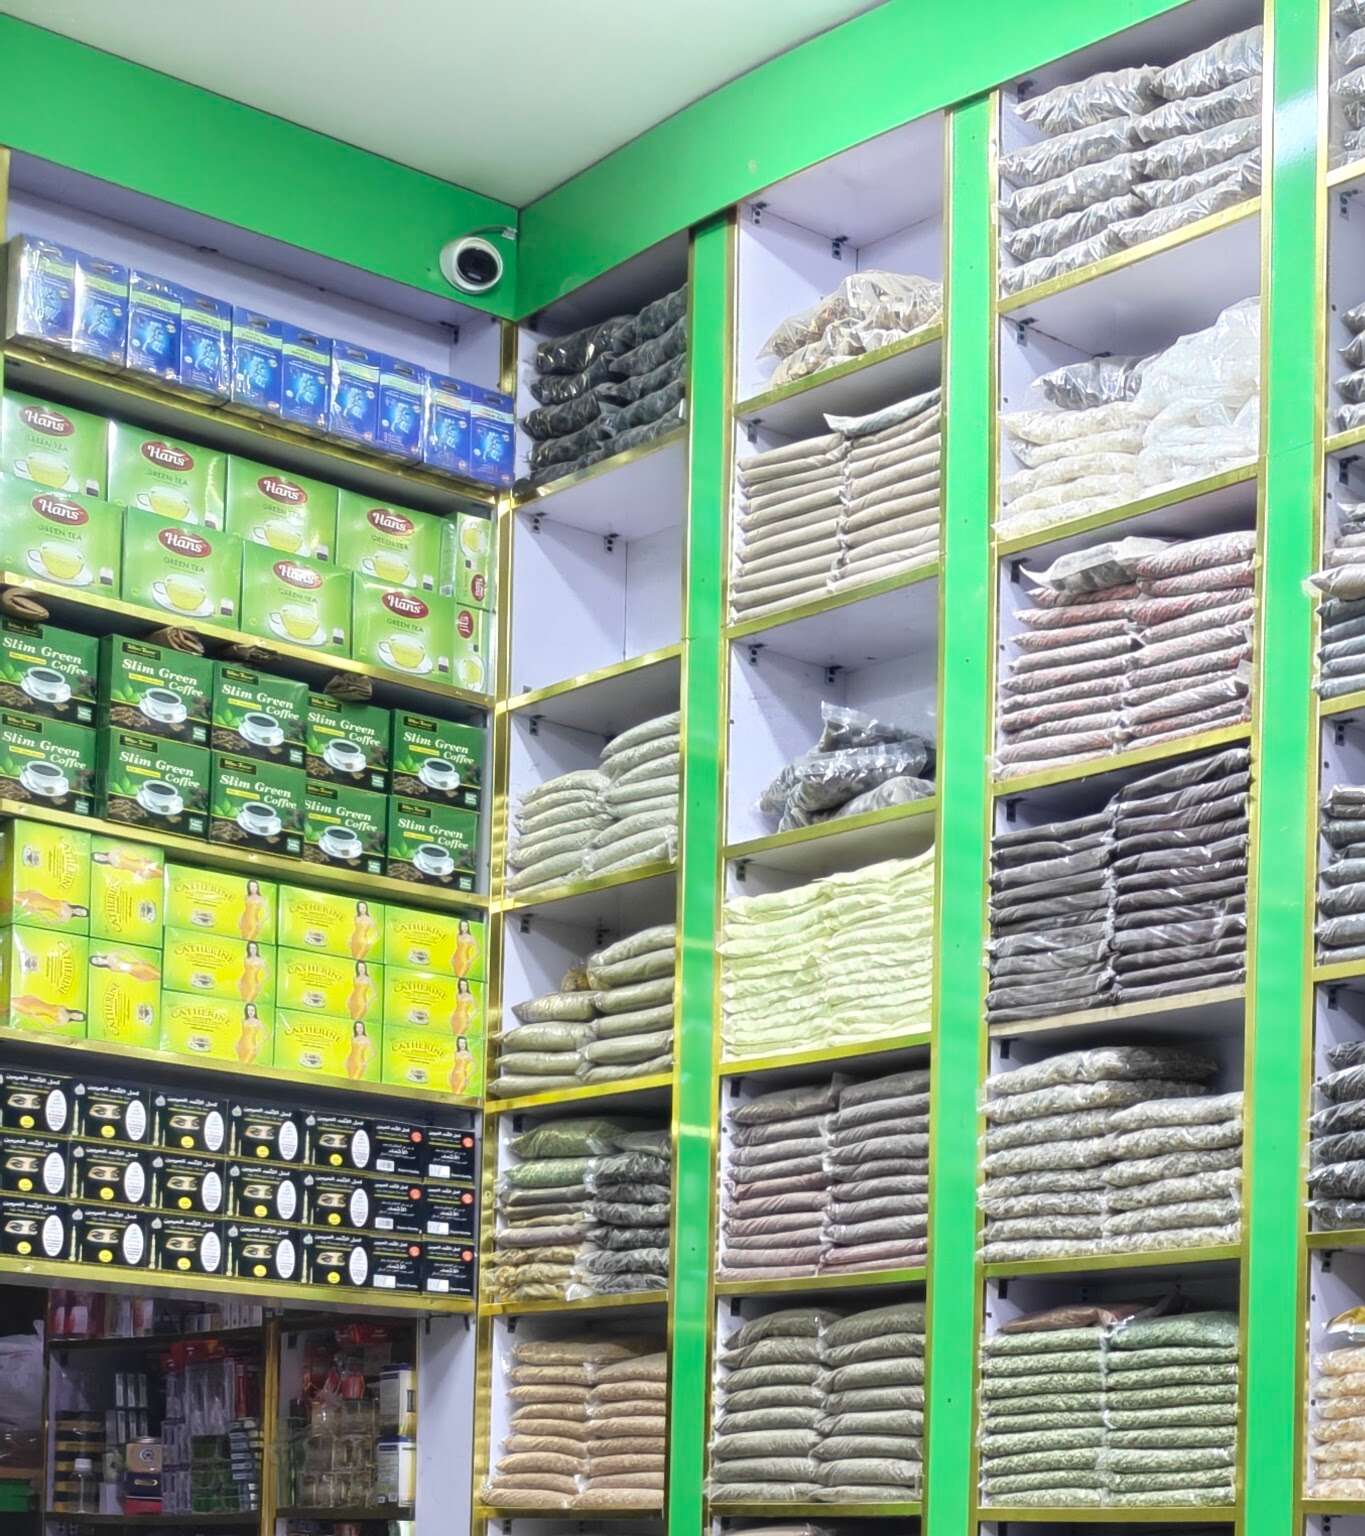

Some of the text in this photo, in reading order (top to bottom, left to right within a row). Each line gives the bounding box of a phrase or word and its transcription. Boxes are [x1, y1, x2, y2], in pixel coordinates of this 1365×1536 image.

[25, 409, 66, 433] Hans
[147, 445, 186, 467] Hans
[263, 479, 301, 501] Hans
[39, 499, 81, 521] Hans
[373, 511, 408, 533] Hans
[164, 532, 204, 553] Hans
[388, 595, 422, 615] Hans
[3, 637, 82, 665] Slim Green
[51, 659, 89, 677] Coffee
[122, 658, 198, 686] Slim Green
[168, 681, 204, 698] Coffee
[222, 684, 253, 700] Slim
[257, 692, 294, 709] Green
[266, 704, 300, 721] Coffee
[307, 712, 376, 736] Slim Green
[2, 731, 81, 758] Slim Green
[349, 732, 382, 747] Coffee
[403, 731, 470, 755] Slim Green
[50, 752, 87, 771] Coffee
[119, 751, 195, 777] Slim Green
[443, 751, 476, 765] Coffee
[165, 772, 201, 790] Coffee
[219, 774, 291, 798] Slim Green
[263, 793, 297, 810] Coffee
[304, 799, 372, 822] Slim Green
[345, 818, 379, 834] Coffee
[397, 818, 464, 840] Slim Green
[437, 837, 470, 851] Coffee
[289, 901, 346, 921] CATHERINE
[393, 921, 448, 940] CATHERINE
[174, 943, 234, 963] CATHERINE
[288, 962, 343, 981] CATHERINE
[393, 981, 448, 1001] CATHERINE
[171, 1007, 232, 1026] CATHERINE
[391, 1039, 446, 1058] CATHERINE
